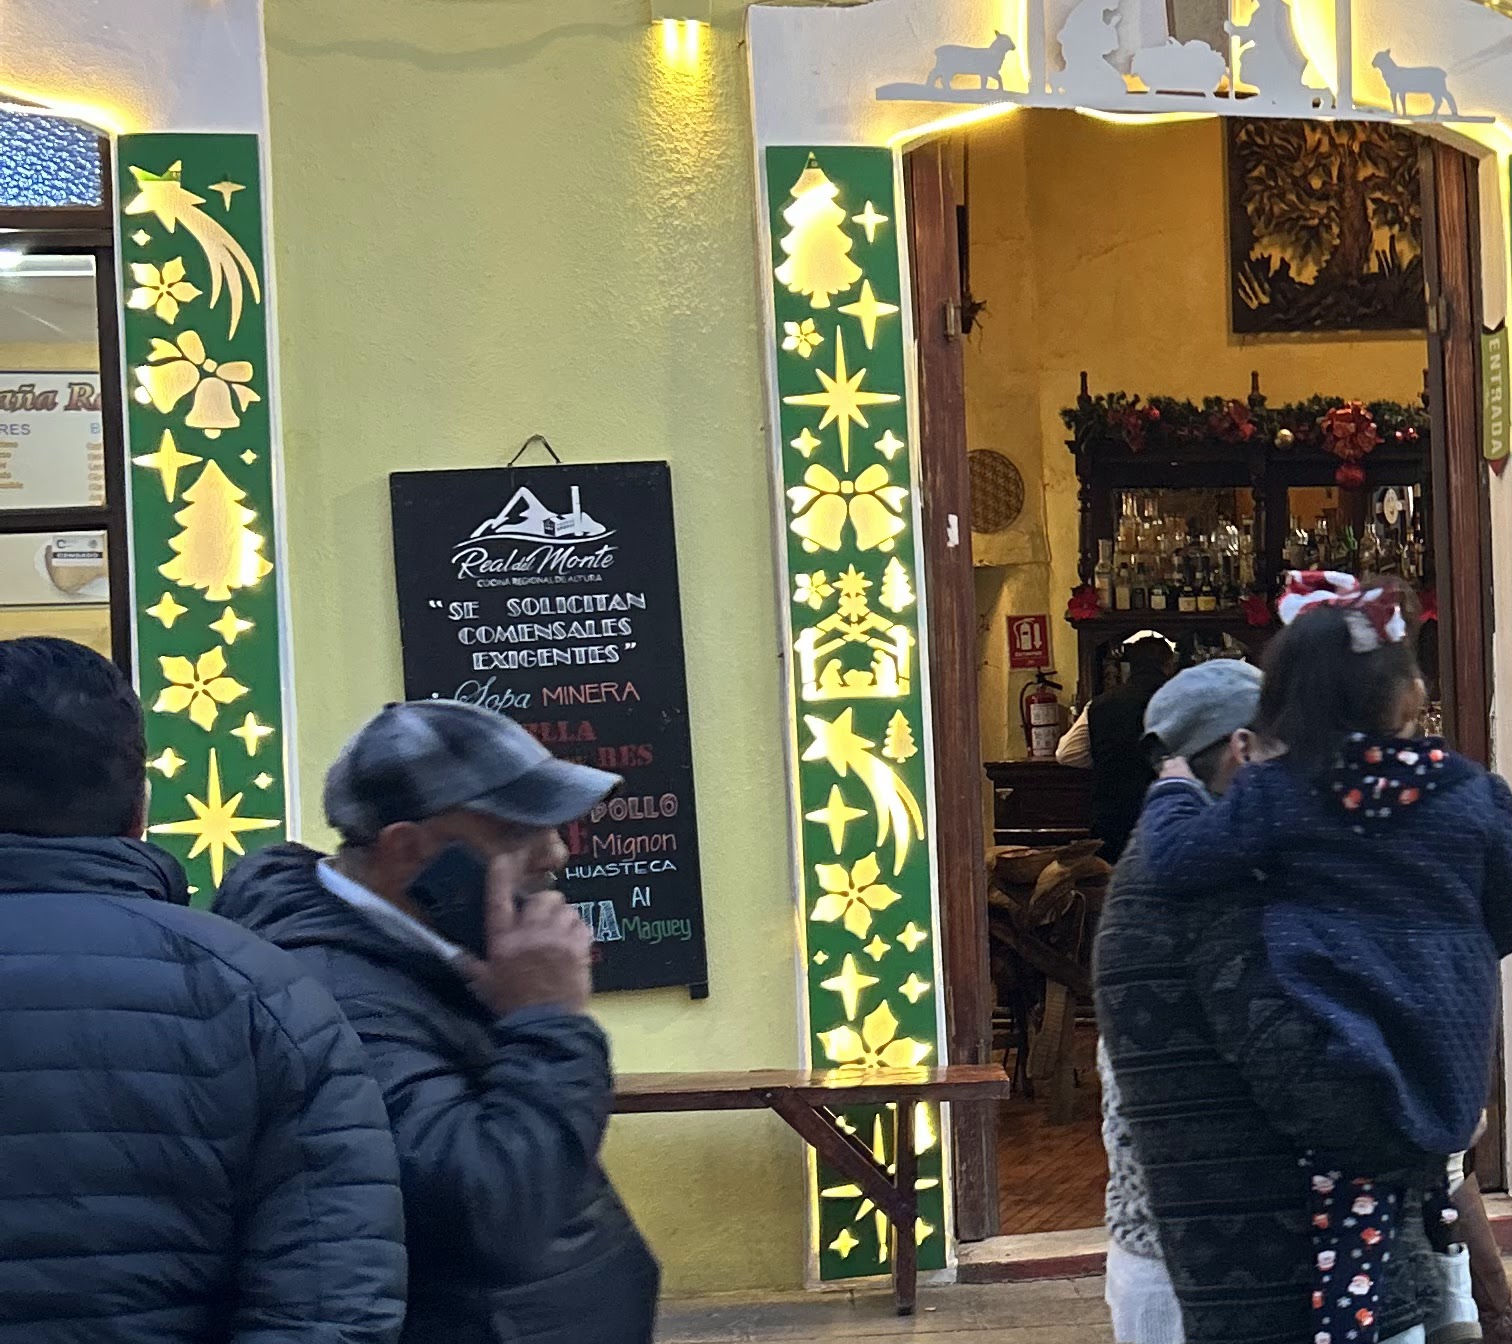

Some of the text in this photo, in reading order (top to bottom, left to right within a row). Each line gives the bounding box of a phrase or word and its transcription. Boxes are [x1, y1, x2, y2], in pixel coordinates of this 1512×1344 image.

[63, 381, 102, 412] R
[1488, 337, 1503, 454] ENTRADA
[452, 545, 619, 580] Real del Monte
[506, 592, 647, 618] SOLICITAN
[457, 617, 633, 645] COMENSALES
[454, 676, 641, 714] Sopa MINERA
[590, 792, 679, 823] POLLO
[592, 833, 677, 862] Mignon
[565, 859, 677, 880] HUASTECA
[621, 916, 692, 945] Maguey
